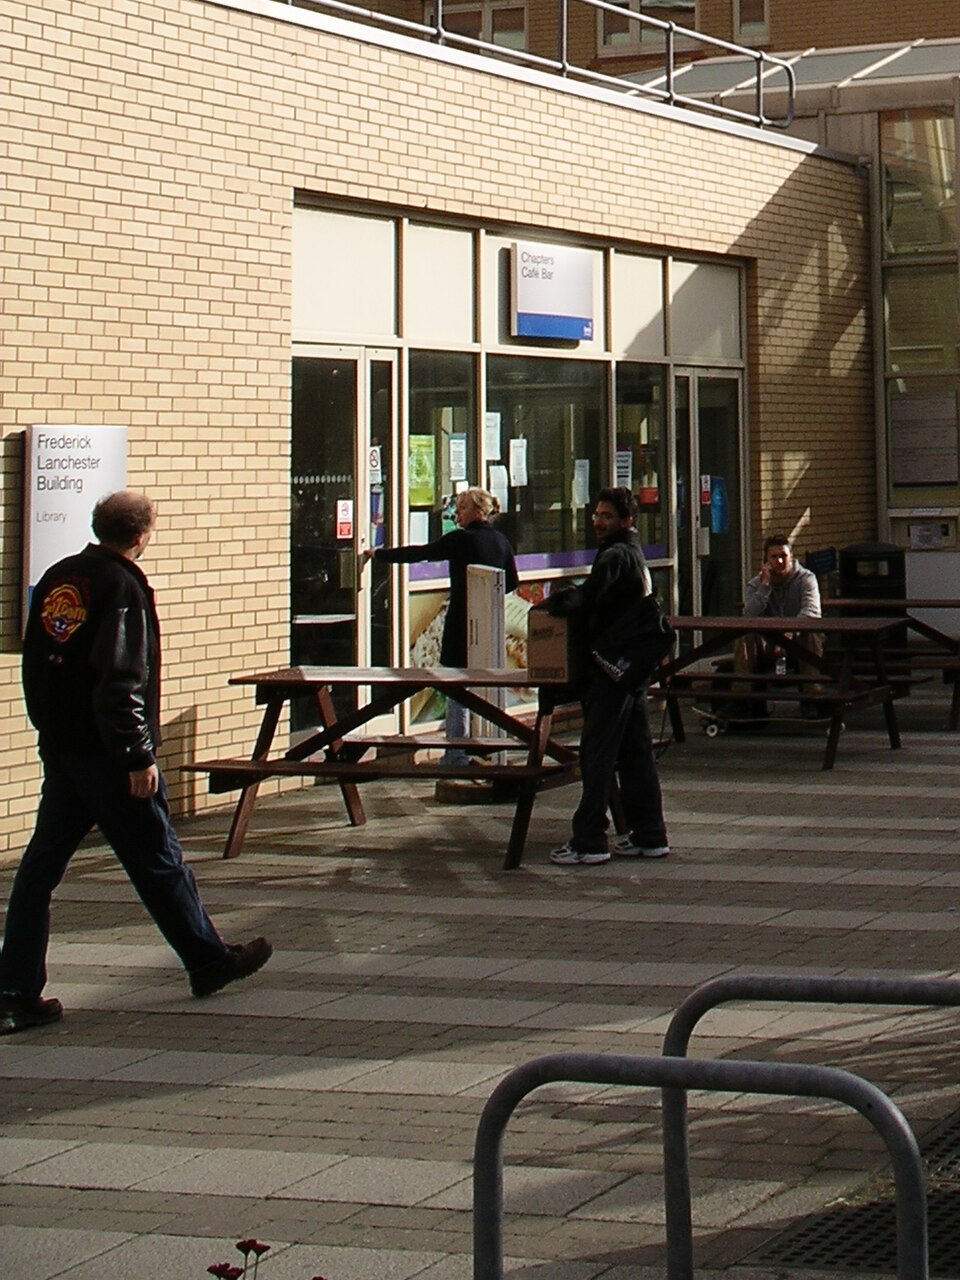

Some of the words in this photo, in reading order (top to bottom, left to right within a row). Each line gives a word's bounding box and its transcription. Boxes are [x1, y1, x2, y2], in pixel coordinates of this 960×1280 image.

[520, 251, 555, 266] Chapters
[541, 267, 554, 280] Bar
[37, 433, 92, 450] Frederick
[36, 454, 102, 471] Lanchester
[36, 475, 84, 494] Building
[36, 511, 68, 524] Library
